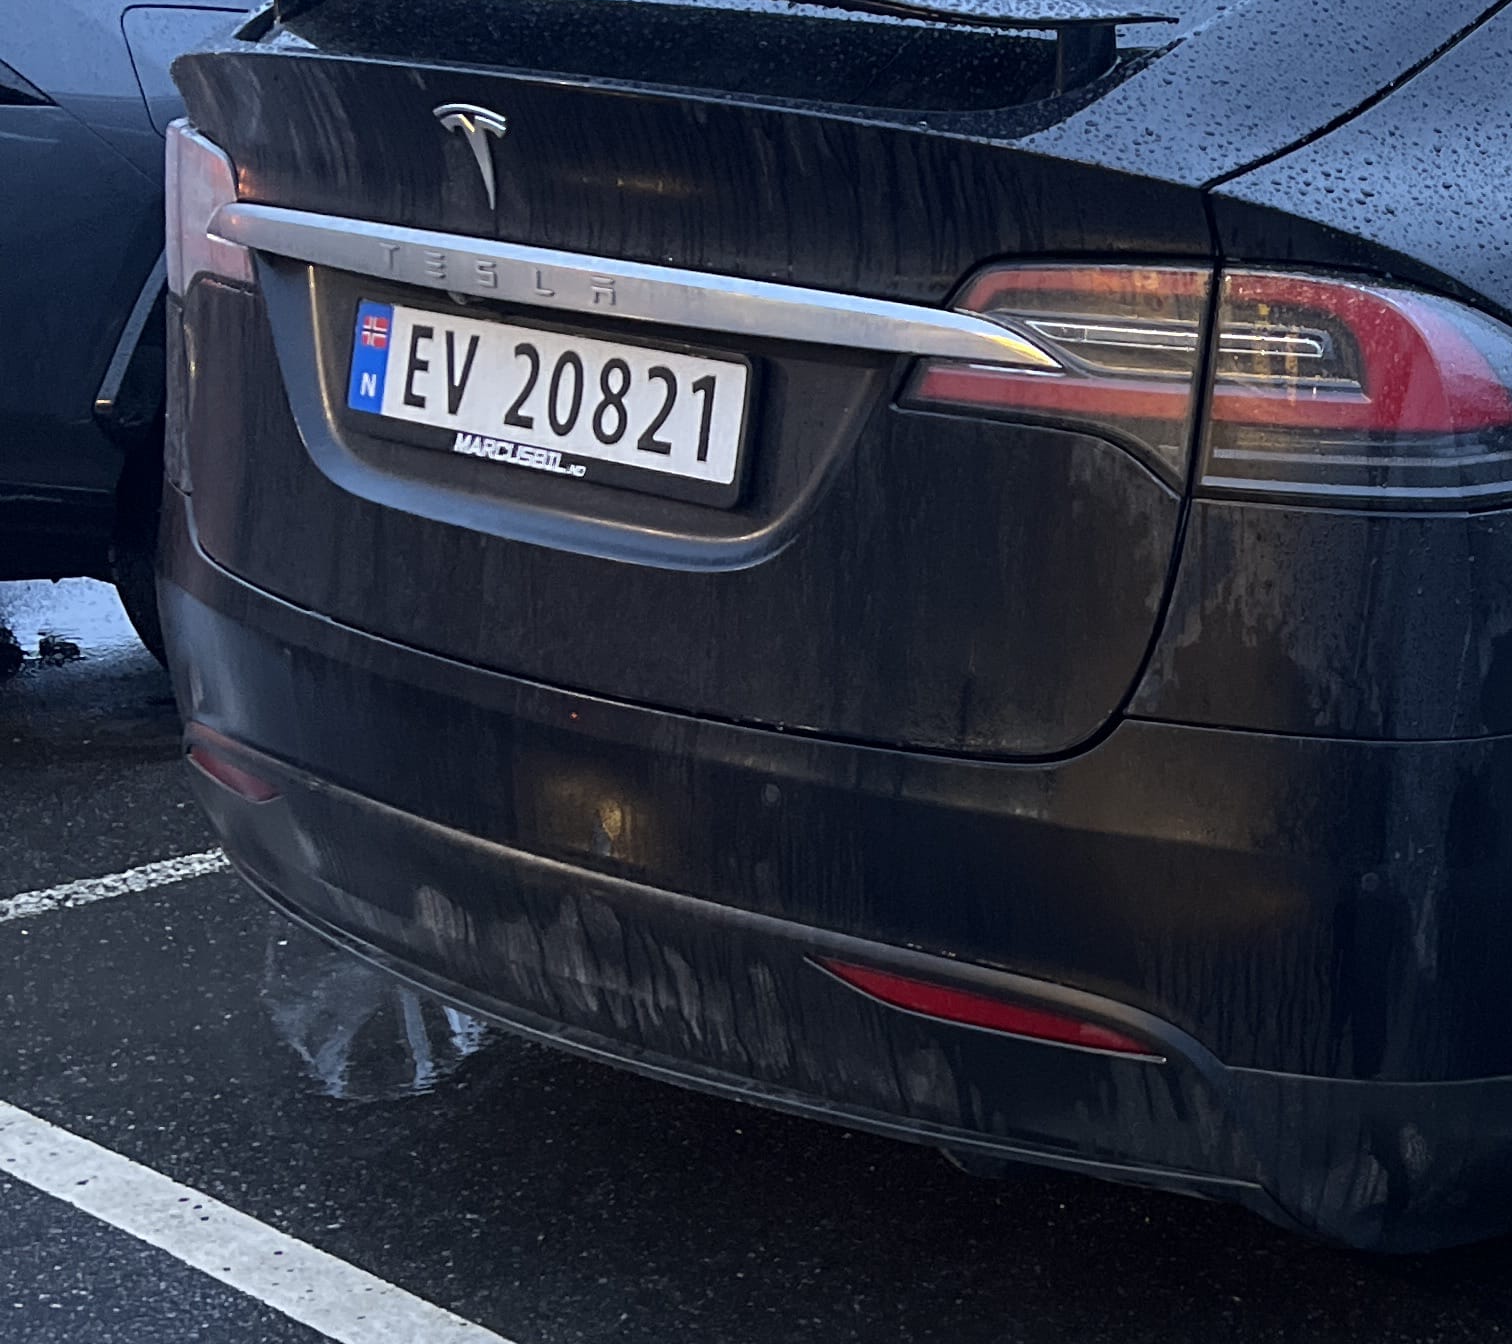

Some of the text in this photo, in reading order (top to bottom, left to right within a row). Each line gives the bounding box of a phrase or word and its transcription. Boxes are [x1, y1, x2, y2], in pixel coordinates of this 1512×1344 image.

[379, 241, 617, 306] TESLA
[359, 372, 377, 398] N
[402, 324, 717, 463] EV 20821
